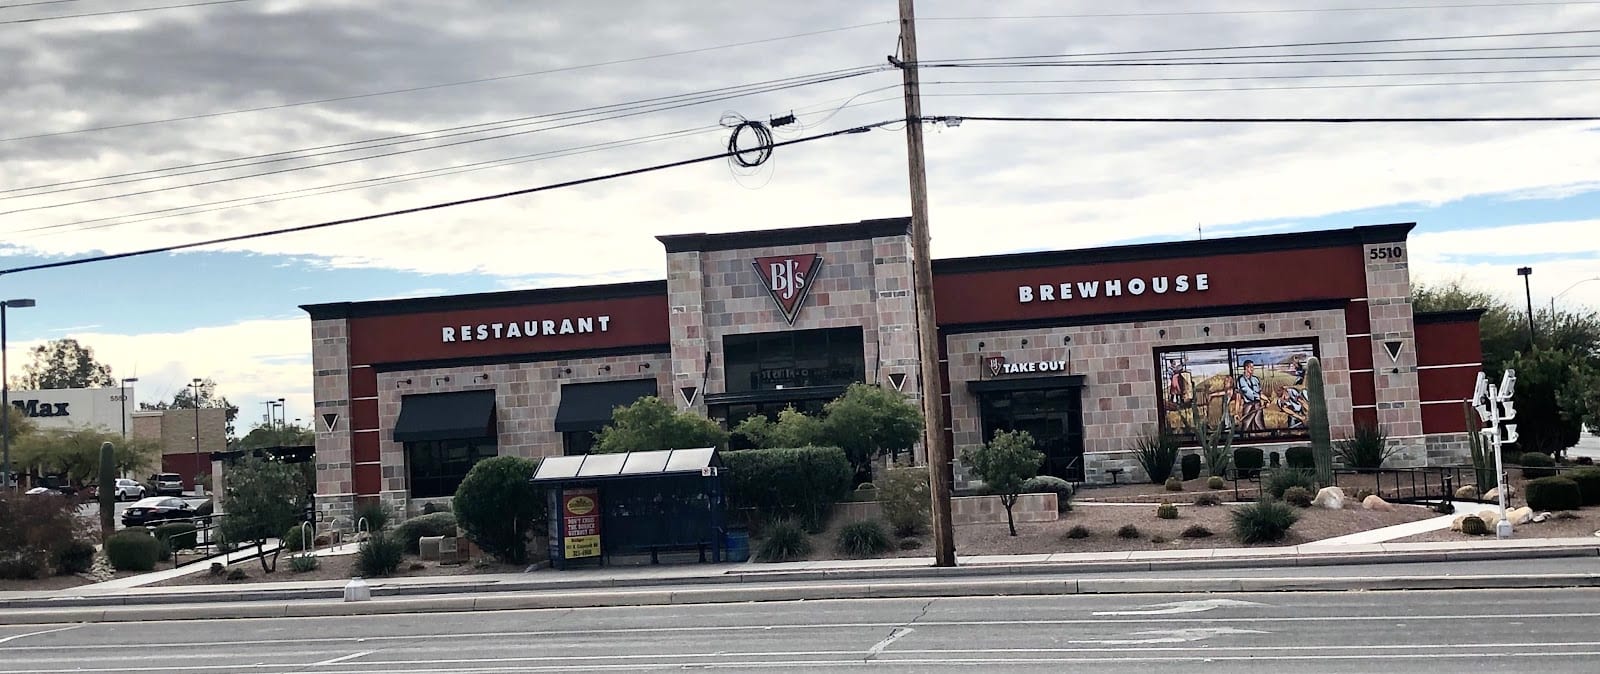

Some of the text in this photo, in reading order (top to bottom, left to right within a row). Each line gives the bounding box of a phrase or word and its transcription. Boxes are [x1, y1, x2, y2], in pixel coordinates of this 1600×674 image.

[1370, 246, 1402, 259] 5510
[769, 259, 805, 300] BJ's
[1018, 273, 1209, 303] BREWHOUSE
[442, 315, 610, 343] RESTAURANT
[1003, 360, 1066, 373] TAKE OUT
[12, 399, 70, 418] Max
